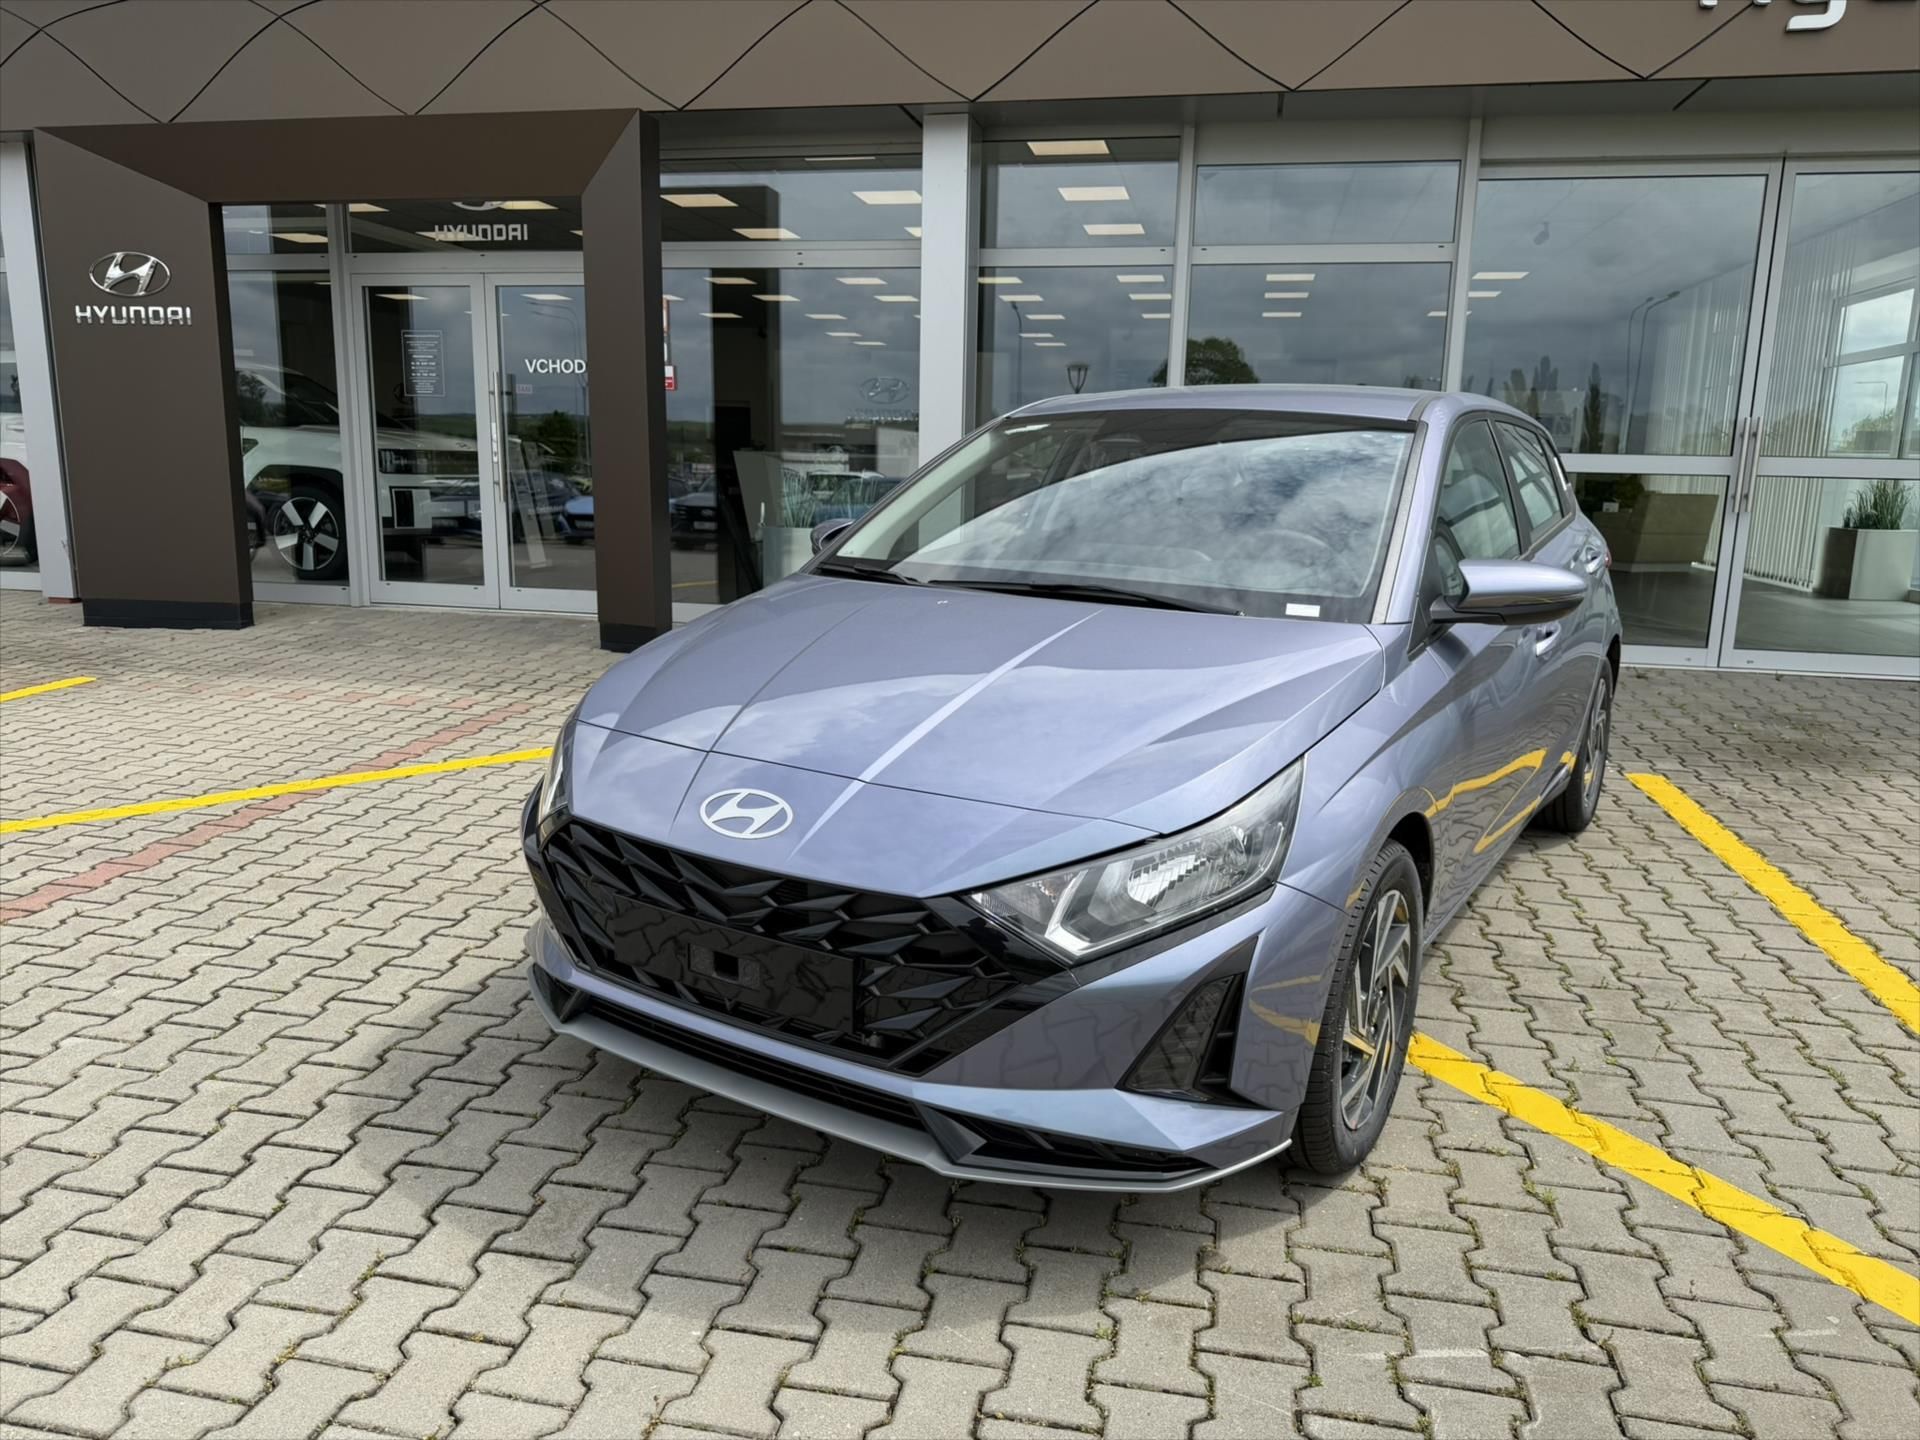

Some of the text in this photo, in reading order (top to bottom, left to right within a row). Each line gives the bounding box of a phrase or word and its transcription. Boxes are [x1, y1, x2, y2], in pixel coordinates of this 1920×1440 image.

[434, 224, 528, 241] HYUNDAI
[75, 305, 192, 325] HYUNDAI
[524, 358, 587, 374] VCHOD
